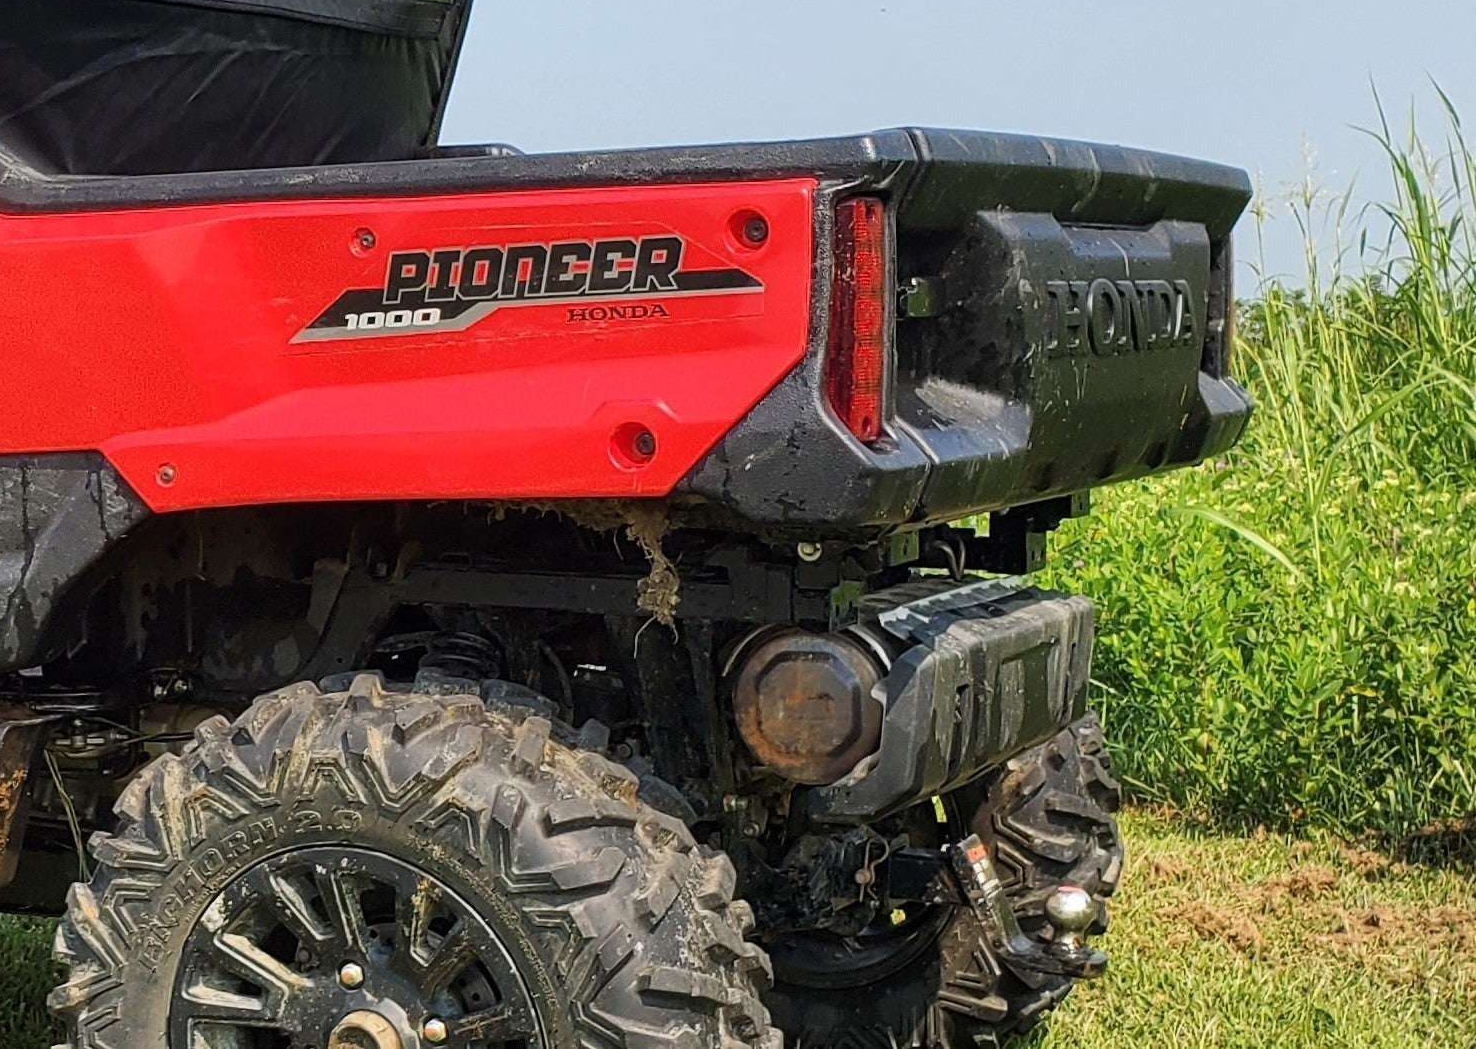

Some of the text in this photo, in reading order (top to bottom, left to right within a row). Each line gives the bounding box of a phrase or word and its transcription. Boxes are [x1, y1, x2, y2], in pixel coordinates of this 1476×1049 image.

[382, 233, 686, 305] PIONEER
[344, 307, 441, 331] 1000
[566, 303, 671, 323] HONDA
[1046, 277, 1196, 356] HONDA
